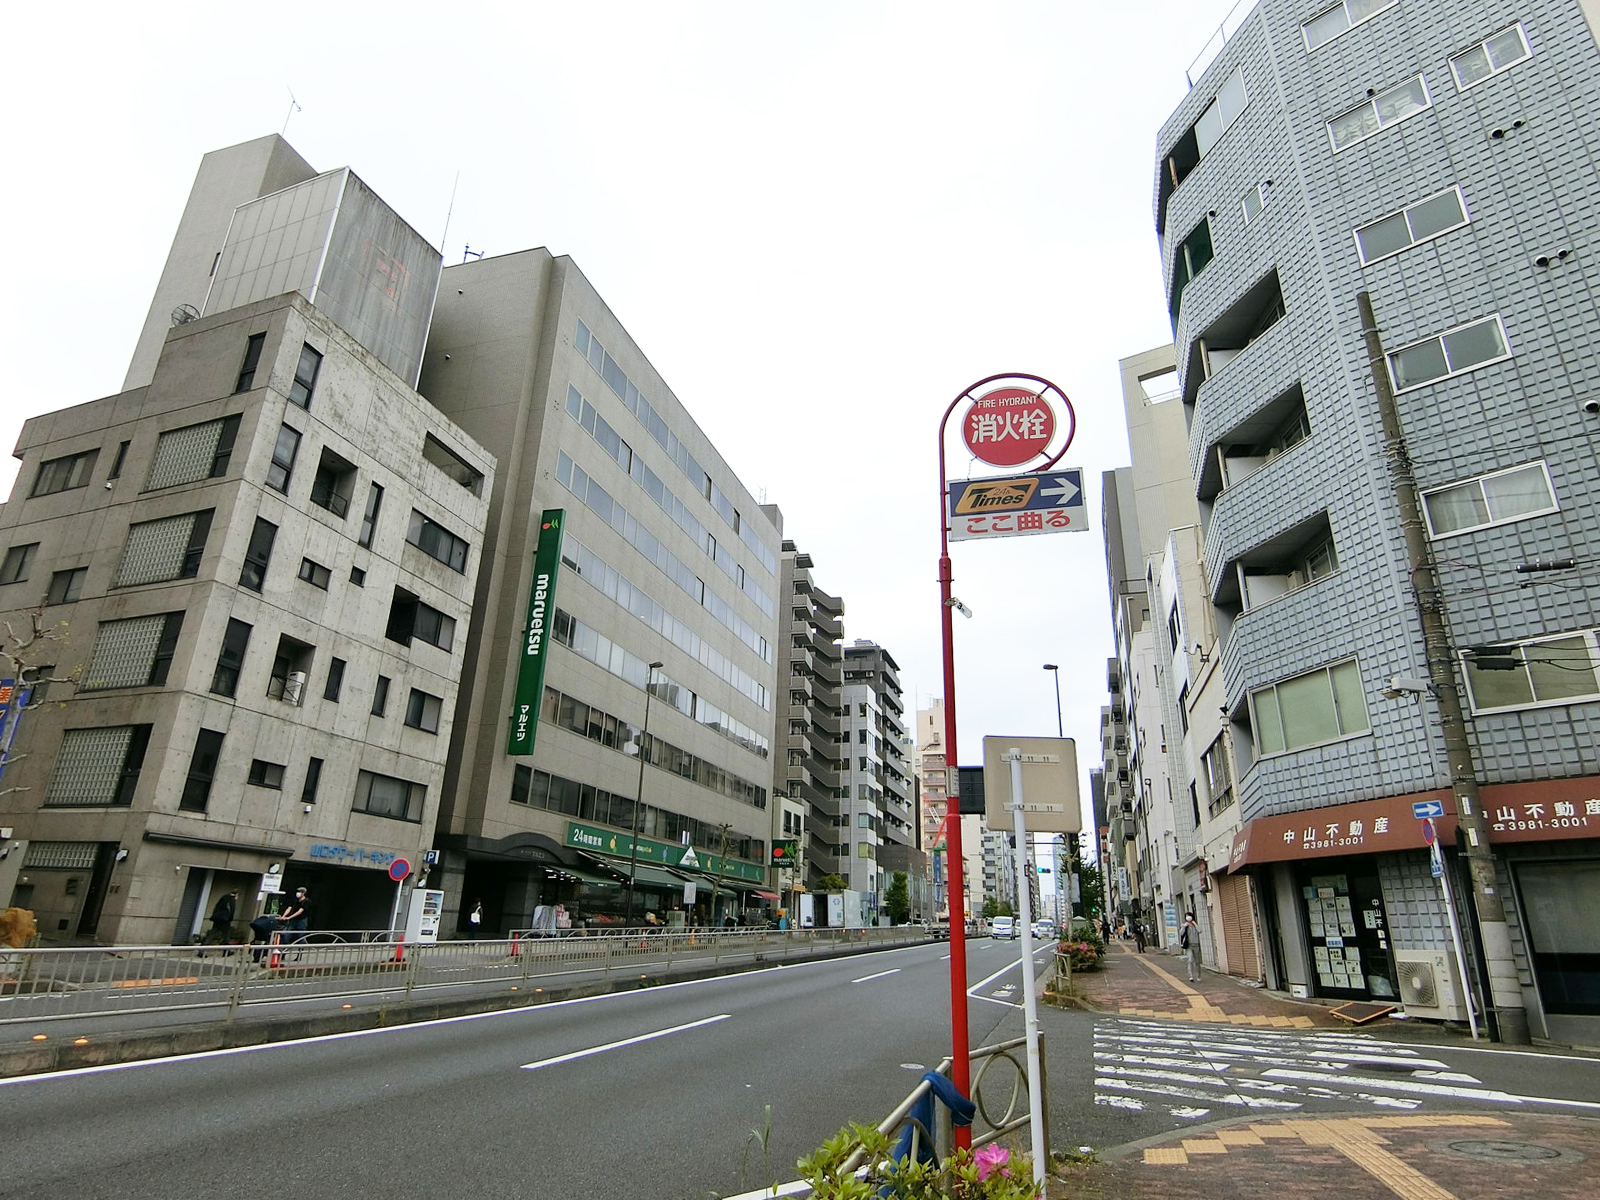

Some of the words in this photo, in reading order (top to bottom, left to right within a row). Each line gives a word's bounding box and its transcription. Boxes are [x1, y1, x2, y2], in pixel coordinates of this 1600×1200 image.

[977, 398, 996, 409] FIRE
[998, 395, 1038, 407] HYDRANT
[970, 408, 1048, 444] 消火栓
[967, 484, 1032, 509] Times
[966, 509, 1071, 534] ここ曲る
[526, 573, 549, 656] maruetsu
[516, 704, 530, 742] マルエツ
[1282, 816, 1389, 844] 中山不動産
[1508, 817, 1588, 831] 3981-3001
[1310, 836, 1364, 849] 3981-3001
[427, 852, 435, 862] P
